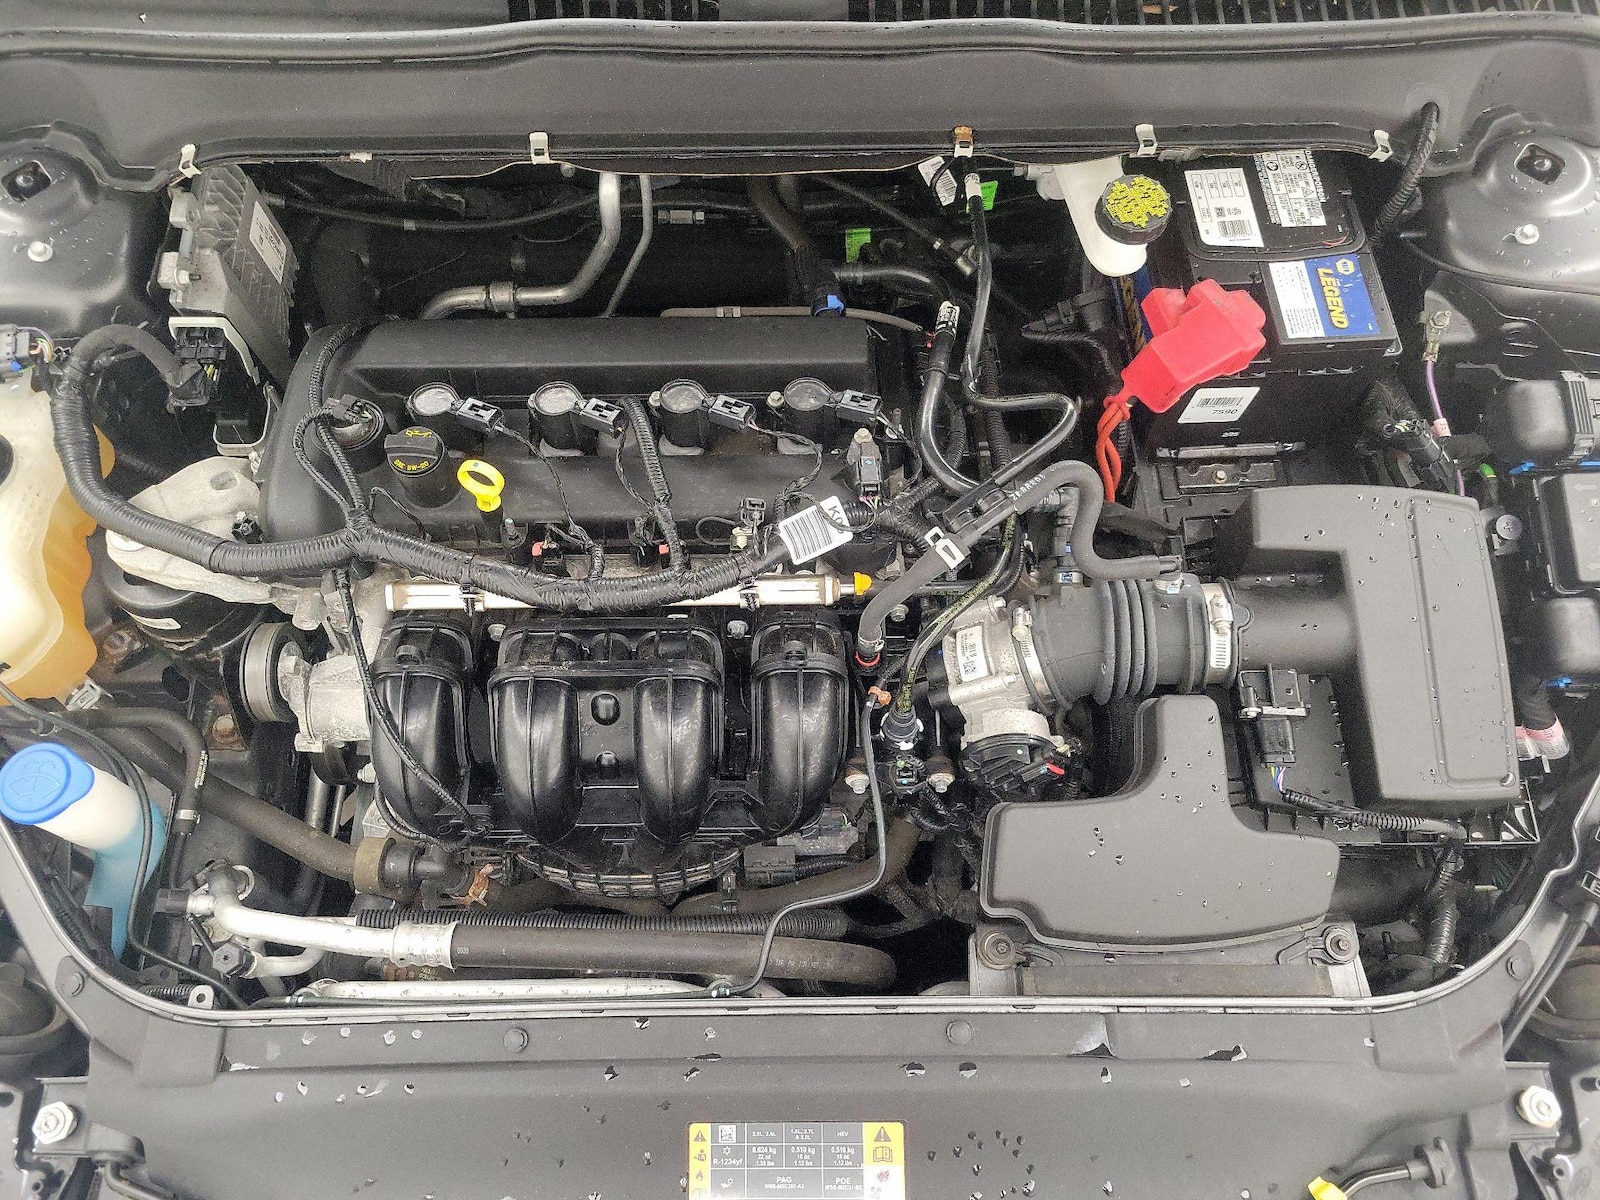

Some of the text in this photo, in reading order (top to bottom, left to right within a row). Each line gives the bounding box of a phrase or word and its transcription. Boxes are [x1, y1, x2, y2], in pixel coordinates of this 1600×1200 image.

[1317, 267, 1350, 329] LEGEND
[768, 1146, 777, 1154] kg
[808, 1146, 816, 1154] kg
[847, 1146, 855, 1154] kg
[713, 1158, 743, 1166] R-1234yf
[835, 1177, 852, 1185] POE
